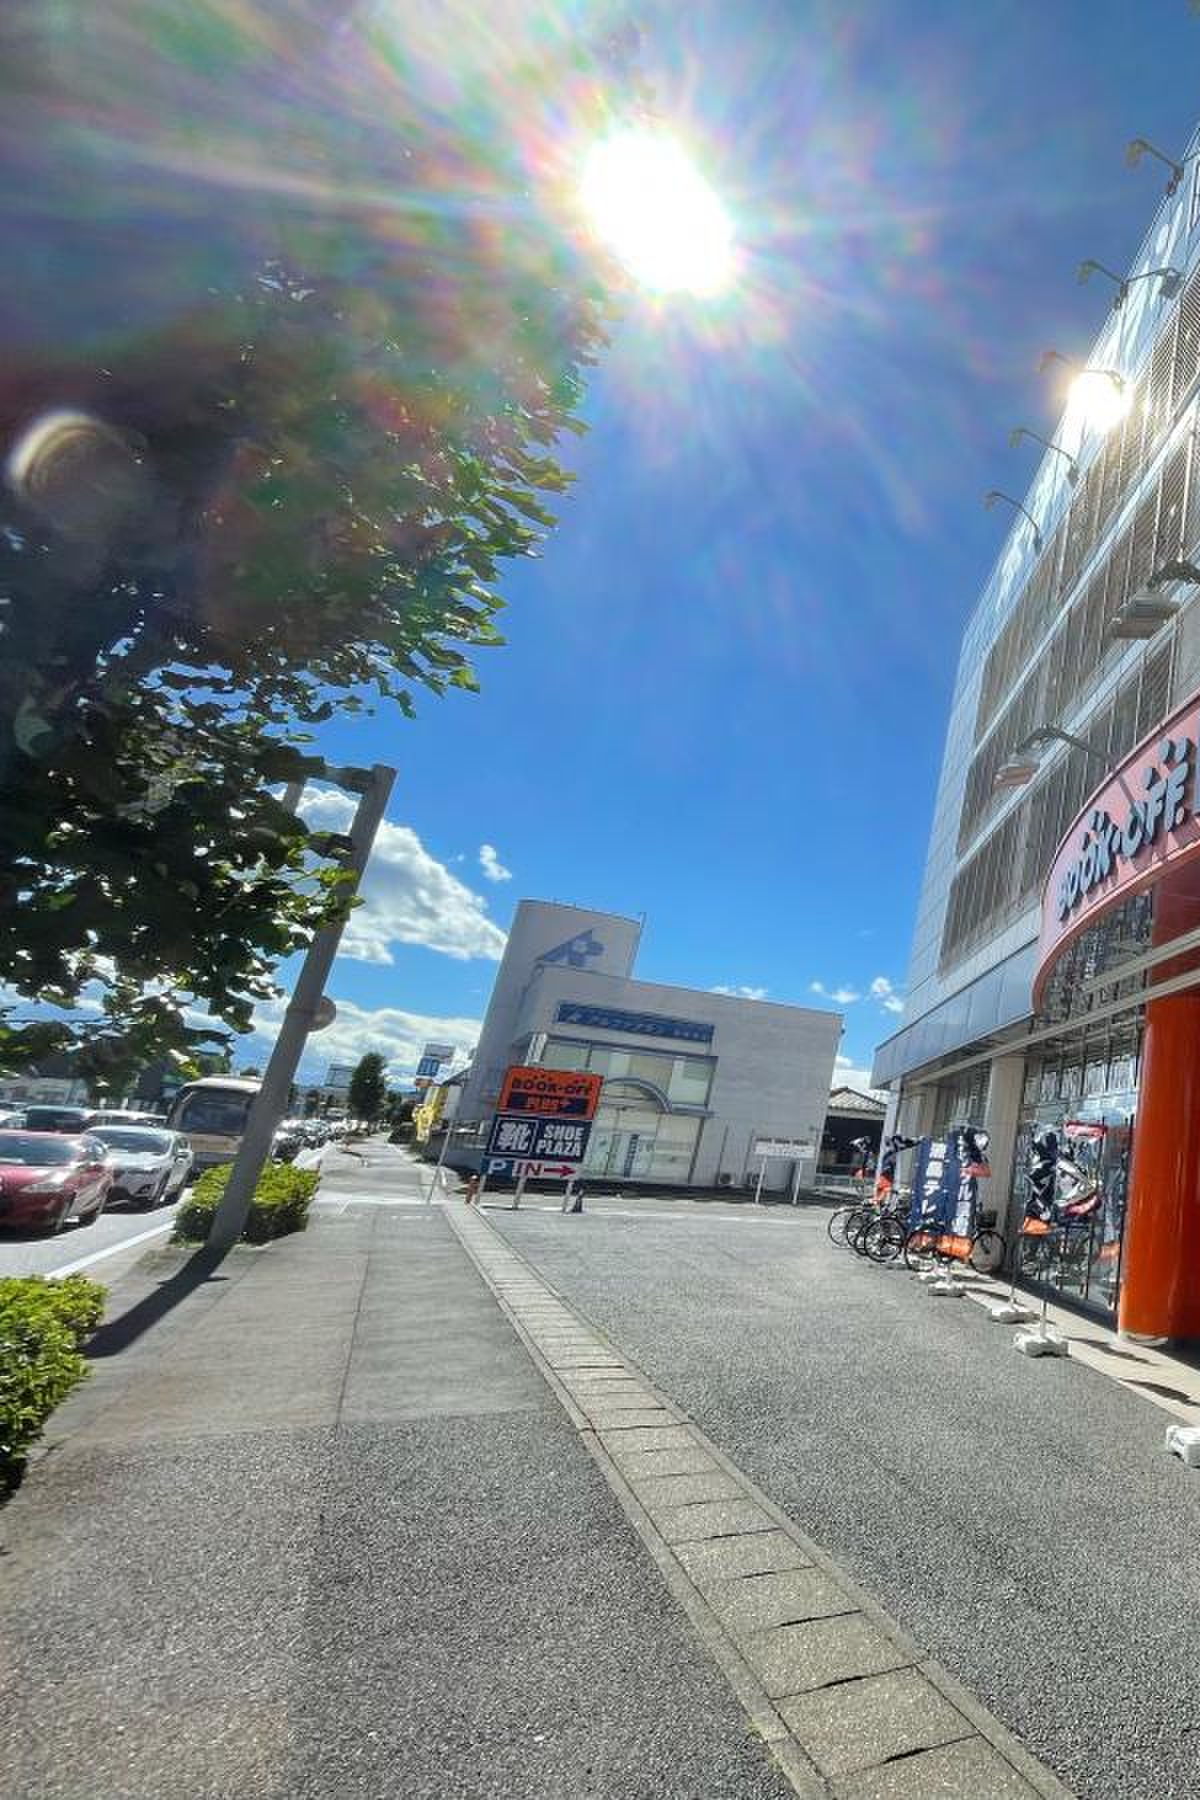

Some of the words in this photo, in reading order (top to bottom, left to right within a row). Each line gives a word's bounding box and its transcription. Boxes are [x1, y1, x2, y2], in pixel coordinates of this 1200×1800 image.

[497, 1121, 532, 1152] 靴
[543, 1124, 585, 1142] SHOE
[535, 1139, 581, 1157] PLAZA
[513, 1160, 543, 1177] IN
